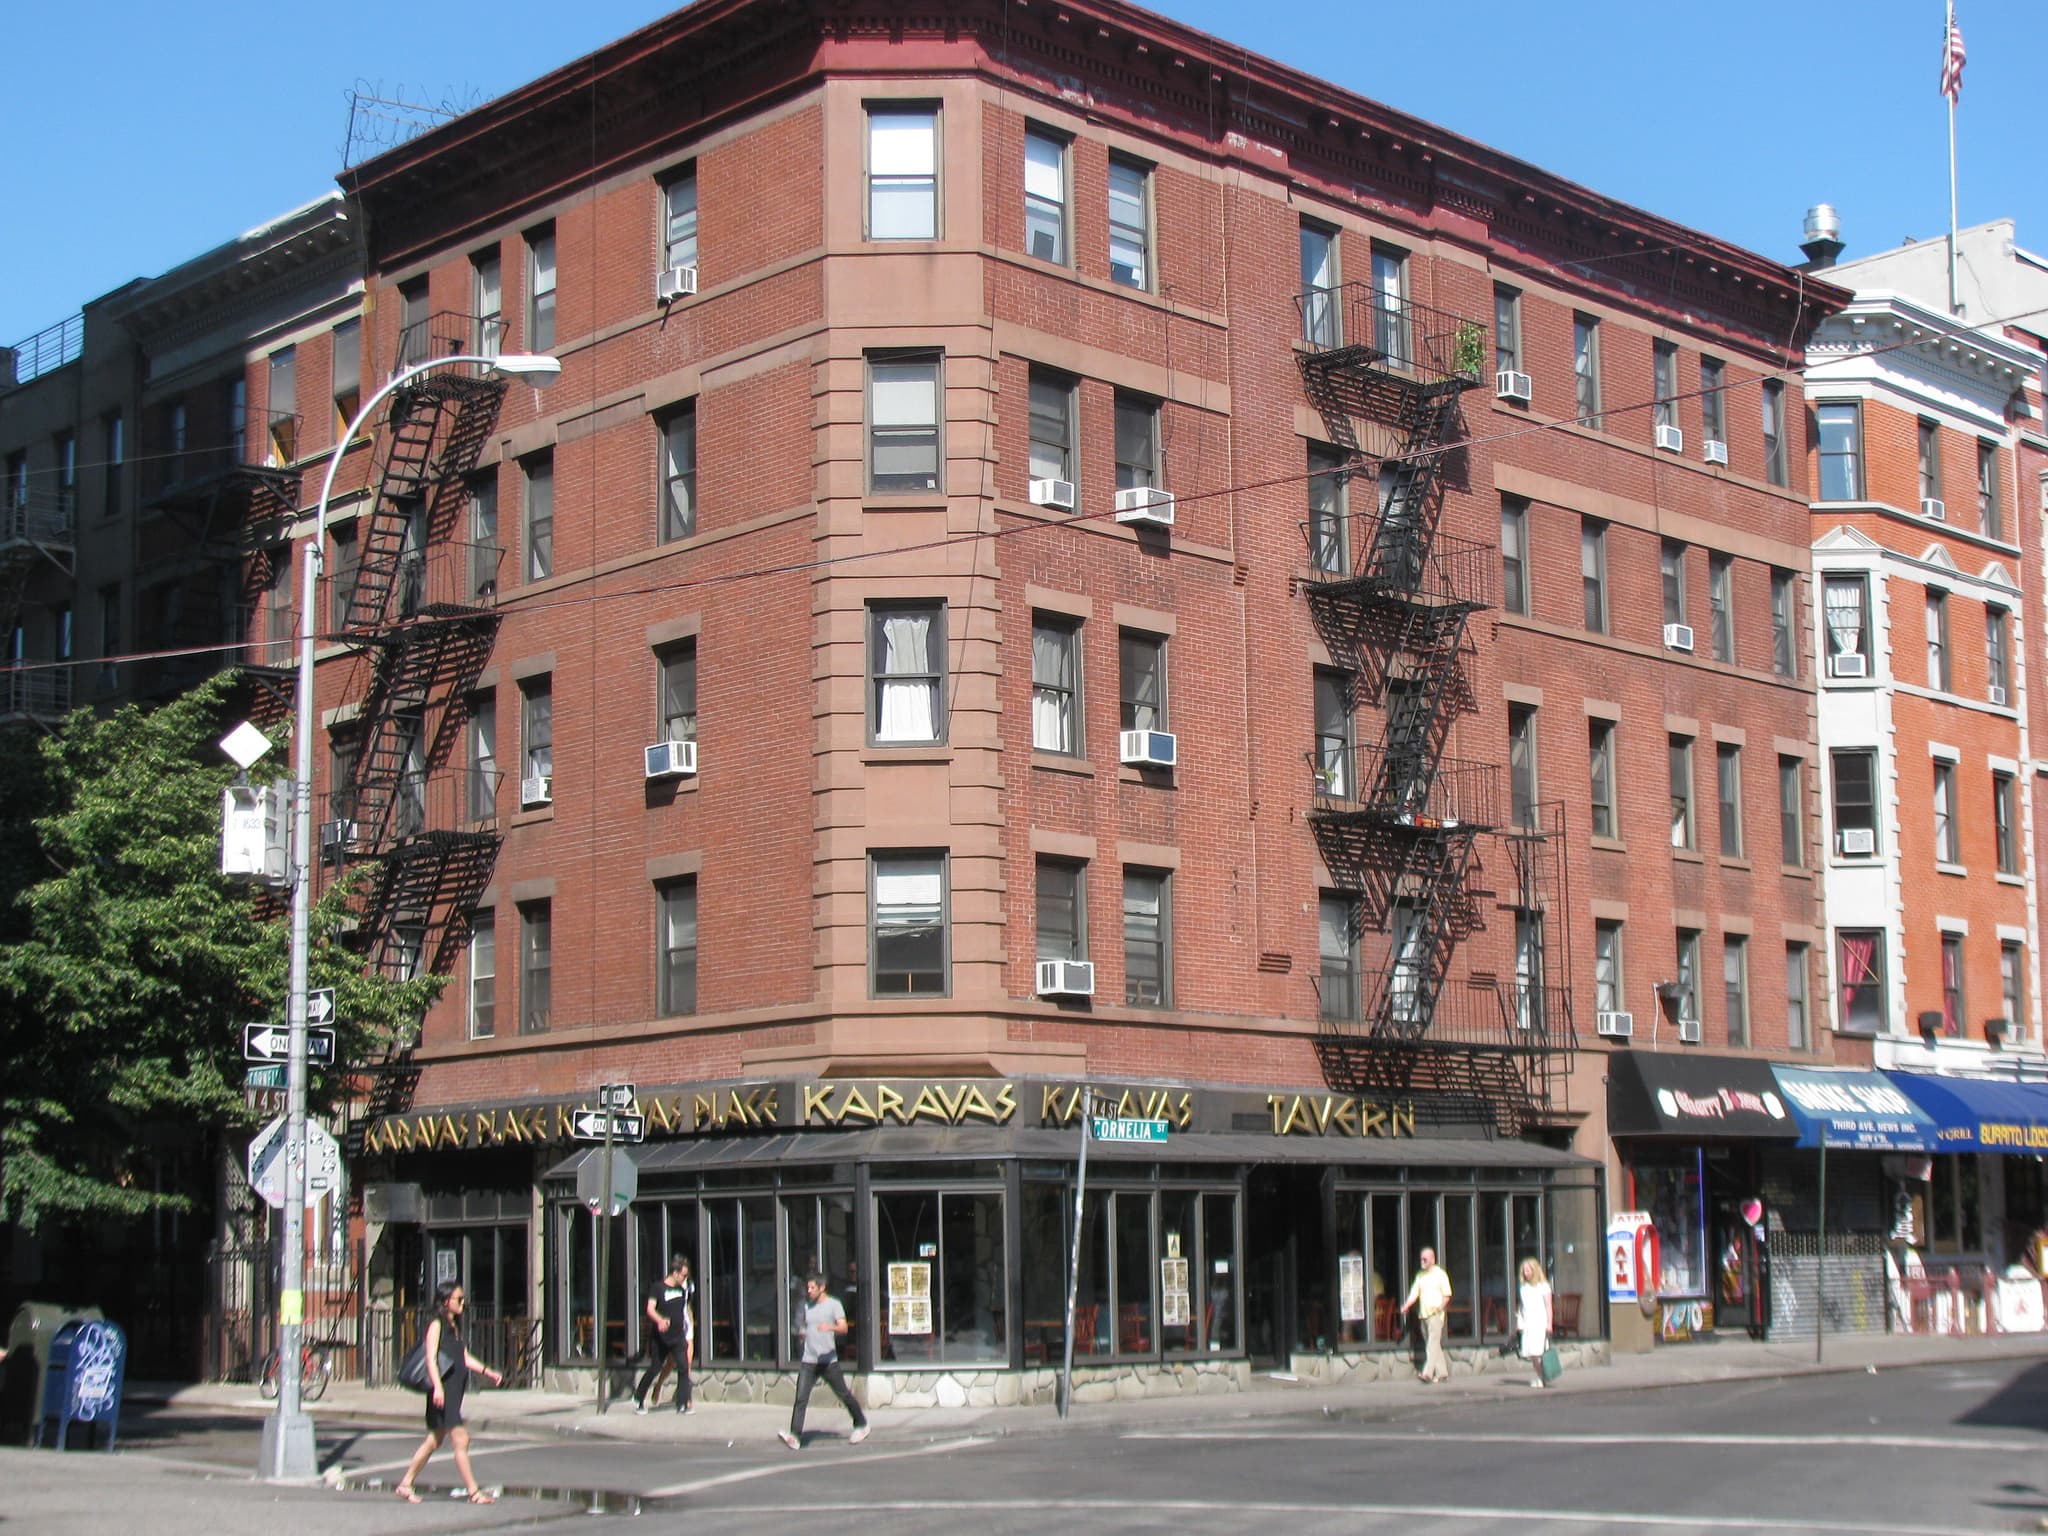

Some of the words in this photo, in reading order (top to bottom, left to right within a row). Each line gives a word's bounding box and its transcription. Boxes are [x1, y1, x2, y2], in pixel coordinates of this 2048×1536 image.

[271, 1036, 289, 1050] ON
[307, 1039, 326, 1054] AY
[260, 1090, 268, 1111] 4
[273, 1091, 287, 1112] ST
[804, 1084, 1017, 1120] KARAVAS
[1781, 1080, 1867, 1113] SMOKE
[1848, 1085, 1911, 1114] SHOP
[364, 1113, 469, 1152] KARAVAS
[475, 1107, 547, 1145] PLACE
[695, 1088, 778, 1127] PLACE
[1041, 1085, 1193, 1126] KAAVAS
[1267, 1094, 1415, 1137] TAVERN
[1108, 1103, 1118, 1120] ST
[1094, 1121, 1152, 1139] CORNELIA
[1156, 1124, 1165, 1132] ST
[1832, 1120, 1856, 1131] THIRD
[1946, 1127, 1974, 1141] GRILL
[1980, 1123, 2023, 1146] BURRITO
[1615, 1246, 1628, 1284] ATM
